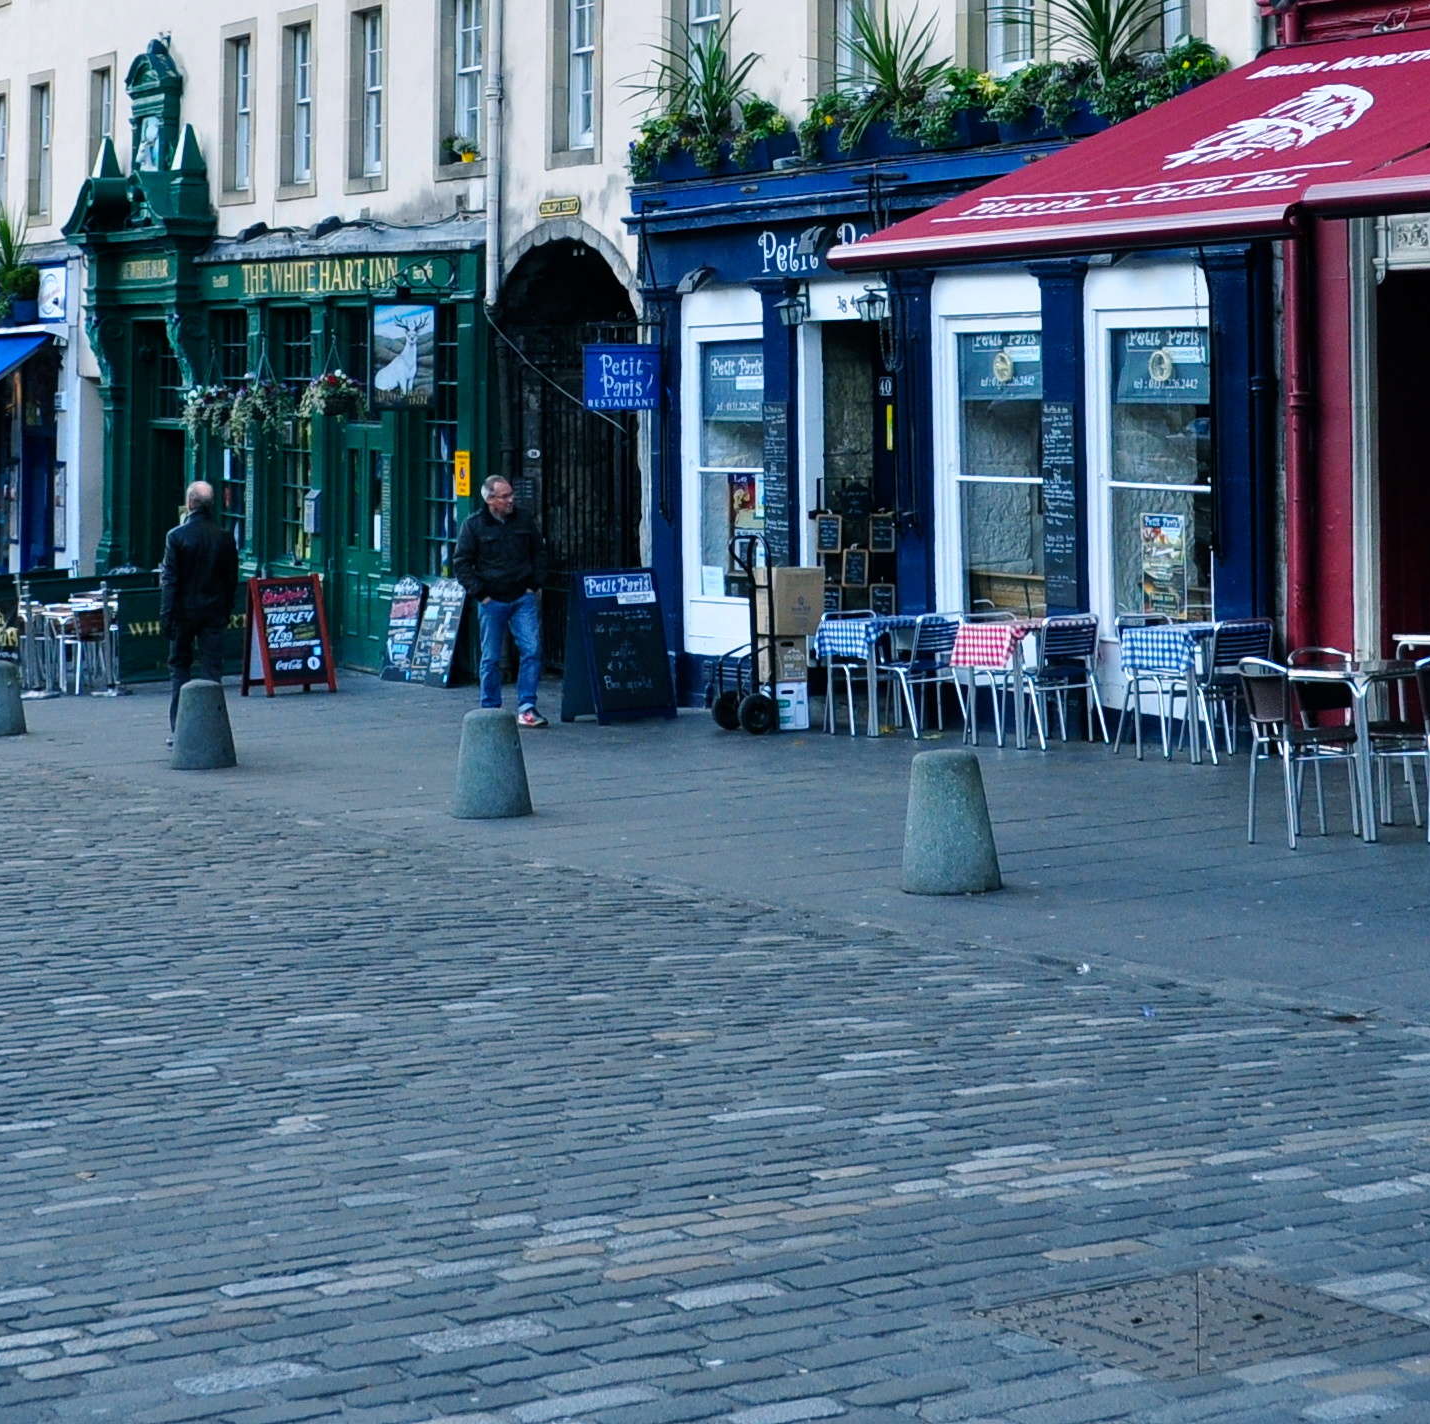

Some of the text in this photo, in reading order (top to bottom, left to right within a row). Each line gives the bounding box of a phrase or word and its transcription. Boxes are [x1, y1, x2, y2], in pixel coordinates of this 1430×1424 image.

[1246, 63, 1317, 79] BIRRA
[959, 197, 1088, 216] Pizzeria
[1232, 172, 1308, 191] Bar
[241, 263, 269, 294] THE
[270, 260, 316, 293] WHITE
[319, 258, 365, 292] HART
[368, 256, 399, 290] INN
[599, 353, 645, 377] Petit
[599, 375, 643, 398] Paris
[587, 398, 655, 408] RESTAURANT
[584, 576, 650, 595] Petit Paris
[266, 611, 315, 625] TURKEY
